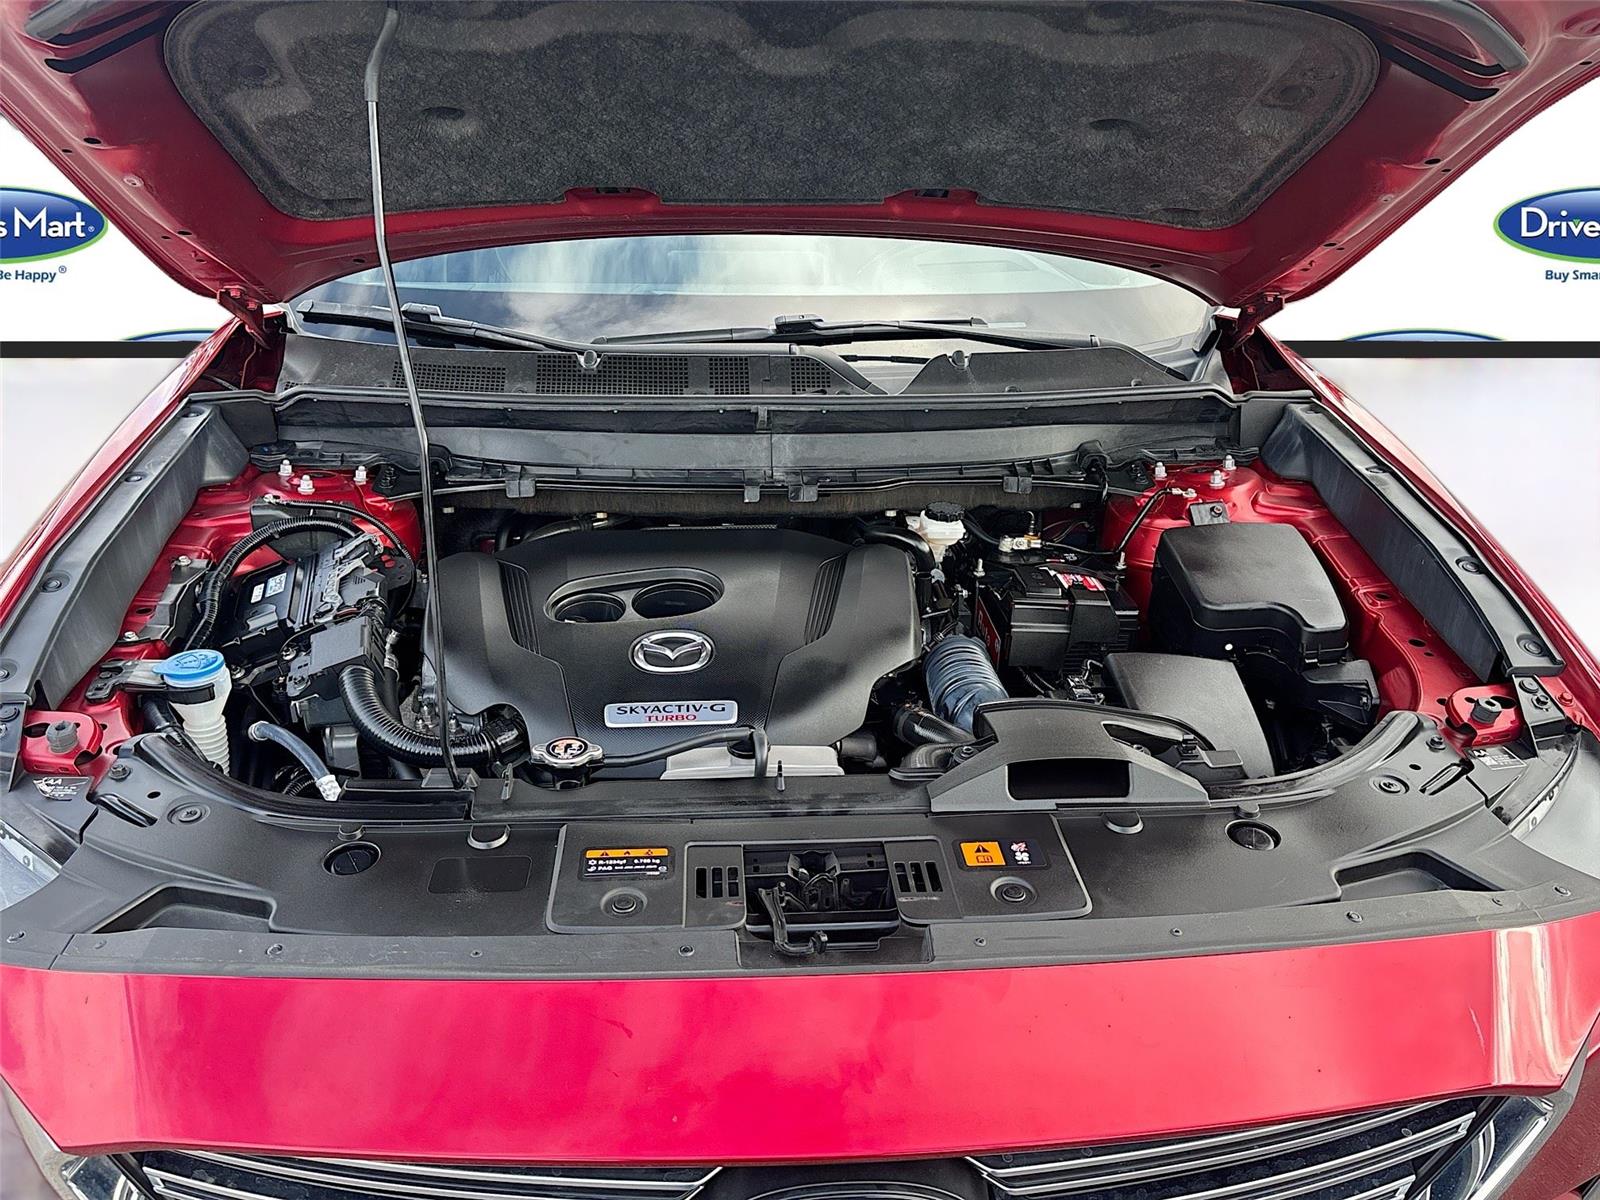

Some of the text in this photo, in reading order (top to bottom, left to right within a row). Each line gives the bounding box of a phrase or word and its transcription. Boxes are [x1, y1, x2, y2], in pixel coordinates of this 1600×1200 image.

[14, 206, 86, 238] Mart
[1520, 206, 1600, 238] Drive
[15, 270, 57, 283] Happy
[1545, 270, 1600, 283] Buy Sma
[616, 703, 726, 715] SKYACTIV-G
[645, 714, 697, 722] TURBO
